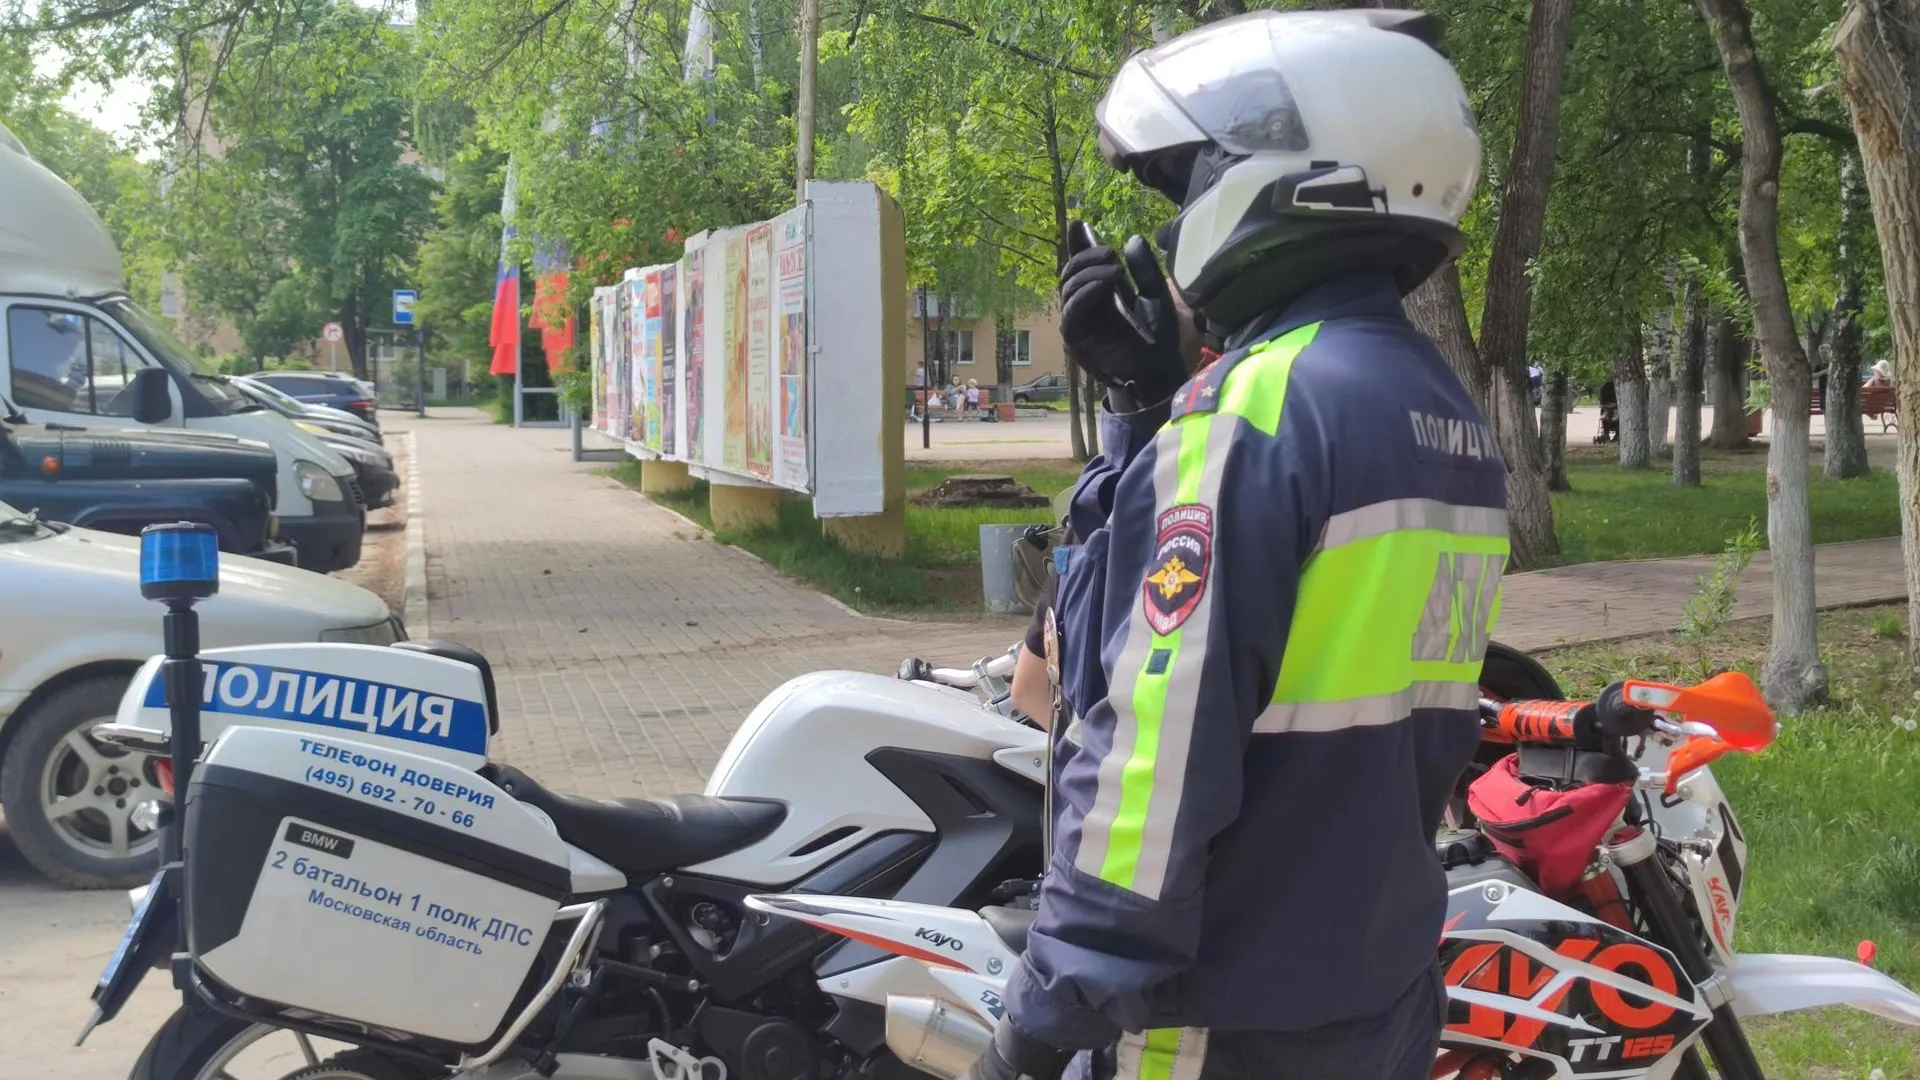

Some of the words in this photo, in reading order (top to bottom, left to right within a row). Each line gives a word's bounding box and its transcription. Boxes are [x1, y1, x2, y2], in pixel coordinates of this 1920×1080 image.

[1409, 410, 1500, 461] ПОЛИЦИ
[1161, 509, 1207, 530] ПОЛИЦИЯ
[1153, 611, 1178, 631] МВД
[300, 738, 398, 777] ТЕЛЕФОН
[400, 768, 496, 810] ДОВЕРИЯ
[305, 765, 355, 794] (495)
[360, 781, 397, 803] 692
[413, 796, 436, 816] 70
[452, 810, 476, 828] 66
[301, 830, 339, 851] BMW
[271, 850, 288, 870] 2
[292, 857, 403, 907] батальон
[411, 894, 422, 912] 1
[426, 902, 481, 932] полк
[482, 917, 534, 947] ДПС
[308, 889, 412, 933] Московская
[415, 926, 484, 956] область
[914, 926, 963, 951] KAYO
[1441, 937, 1678, 1049] AYO
[1568, 1035, 1623, 1063] TT
[1621, 1033, 1676, 1060] 125
